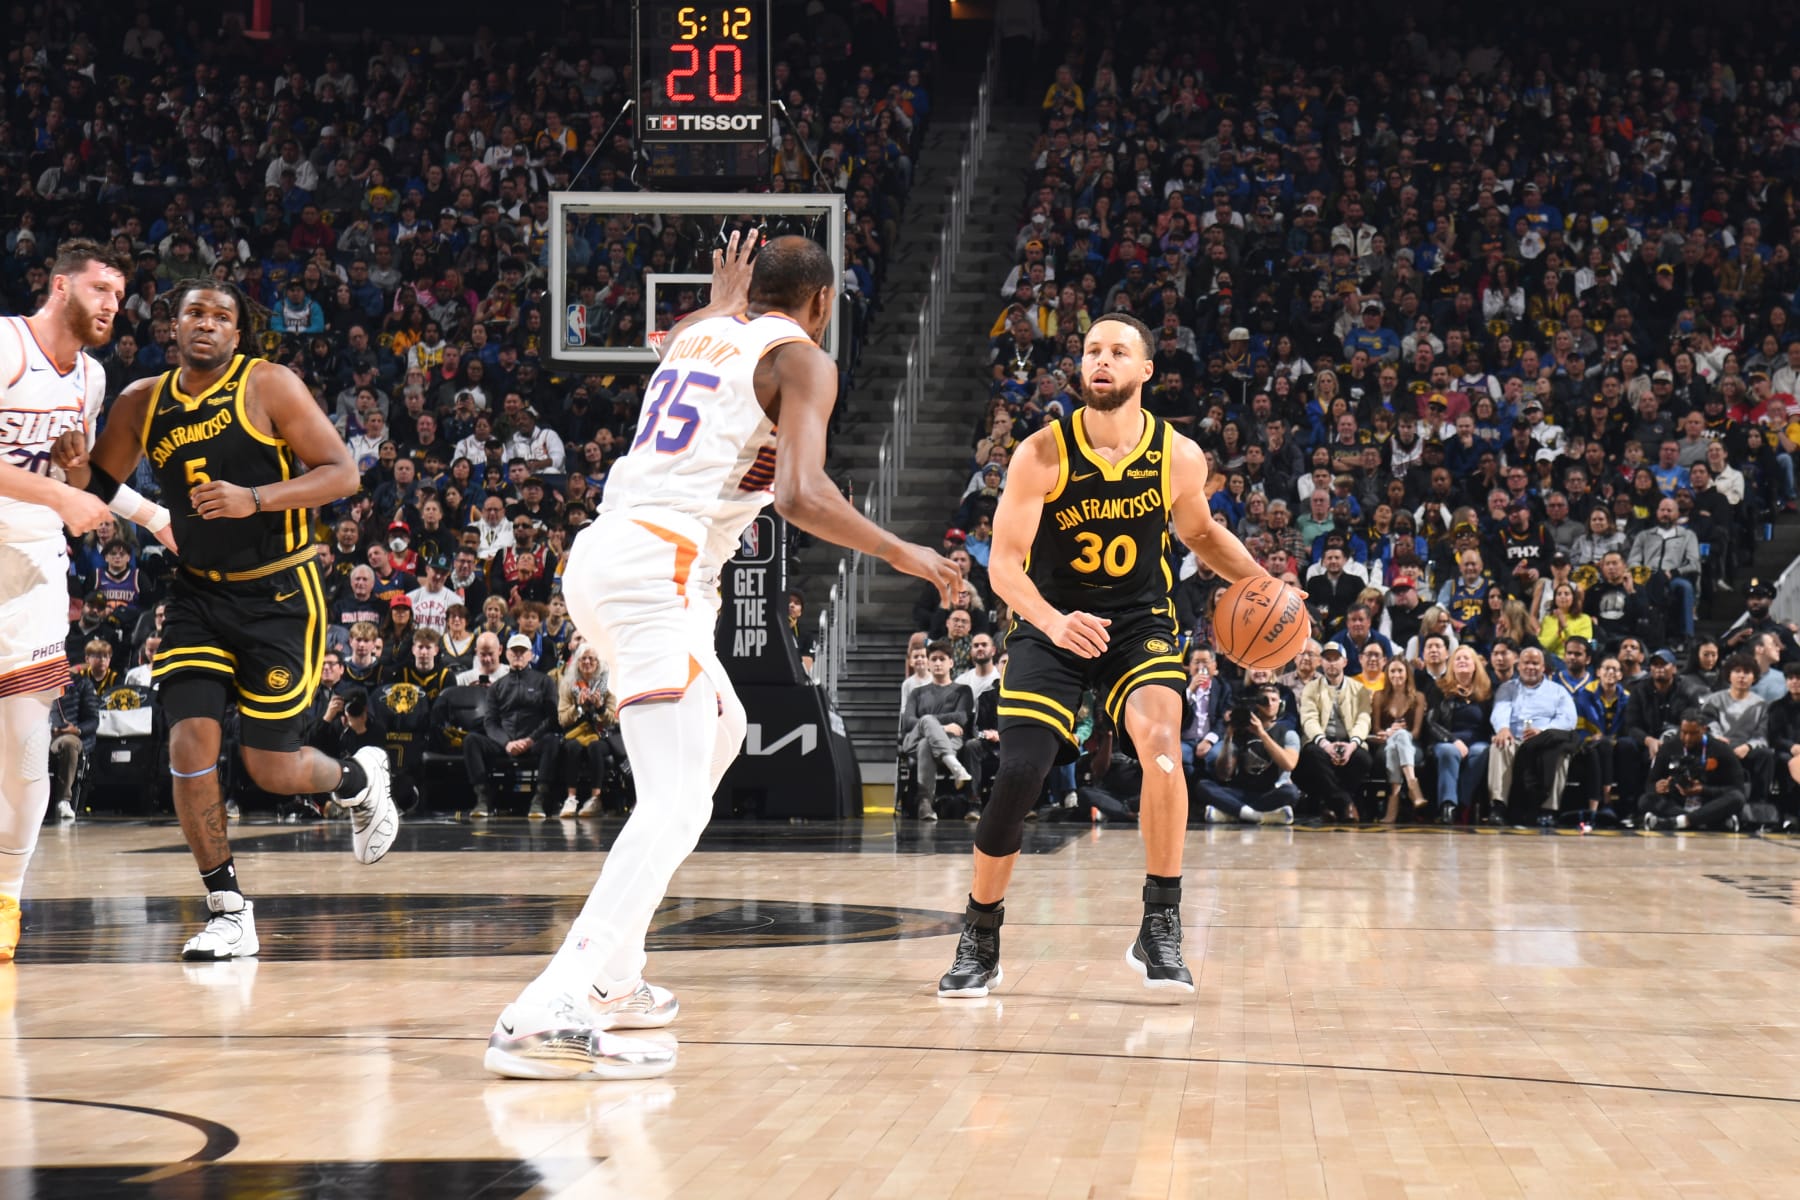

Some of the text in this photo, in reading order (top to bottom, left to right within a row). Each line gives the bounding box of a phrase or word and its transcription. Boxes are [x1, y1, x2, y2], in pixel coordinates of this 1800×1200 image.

[678, 7, 751, 40] 5:12
[666, 44, 742, 102] 20
[678, 114, 762, 130] TISSOT
[632, 368, 722, 455] 35
[152, 408, 232, 468] SAN FRANCISCO
[185, 457, 211, 497] 5
[1127, 469, 1158, 479] Rakuten
[1055, 487, 1162, 531] SAN FRANCISCO
[1070, 531, 1137, 577] 30
[1507, 545, 1540, 559] PHX
[734, 568, 767, 597] GET
[733, 598, 767, 627] THE
[732, 629, 767, 657] APP
